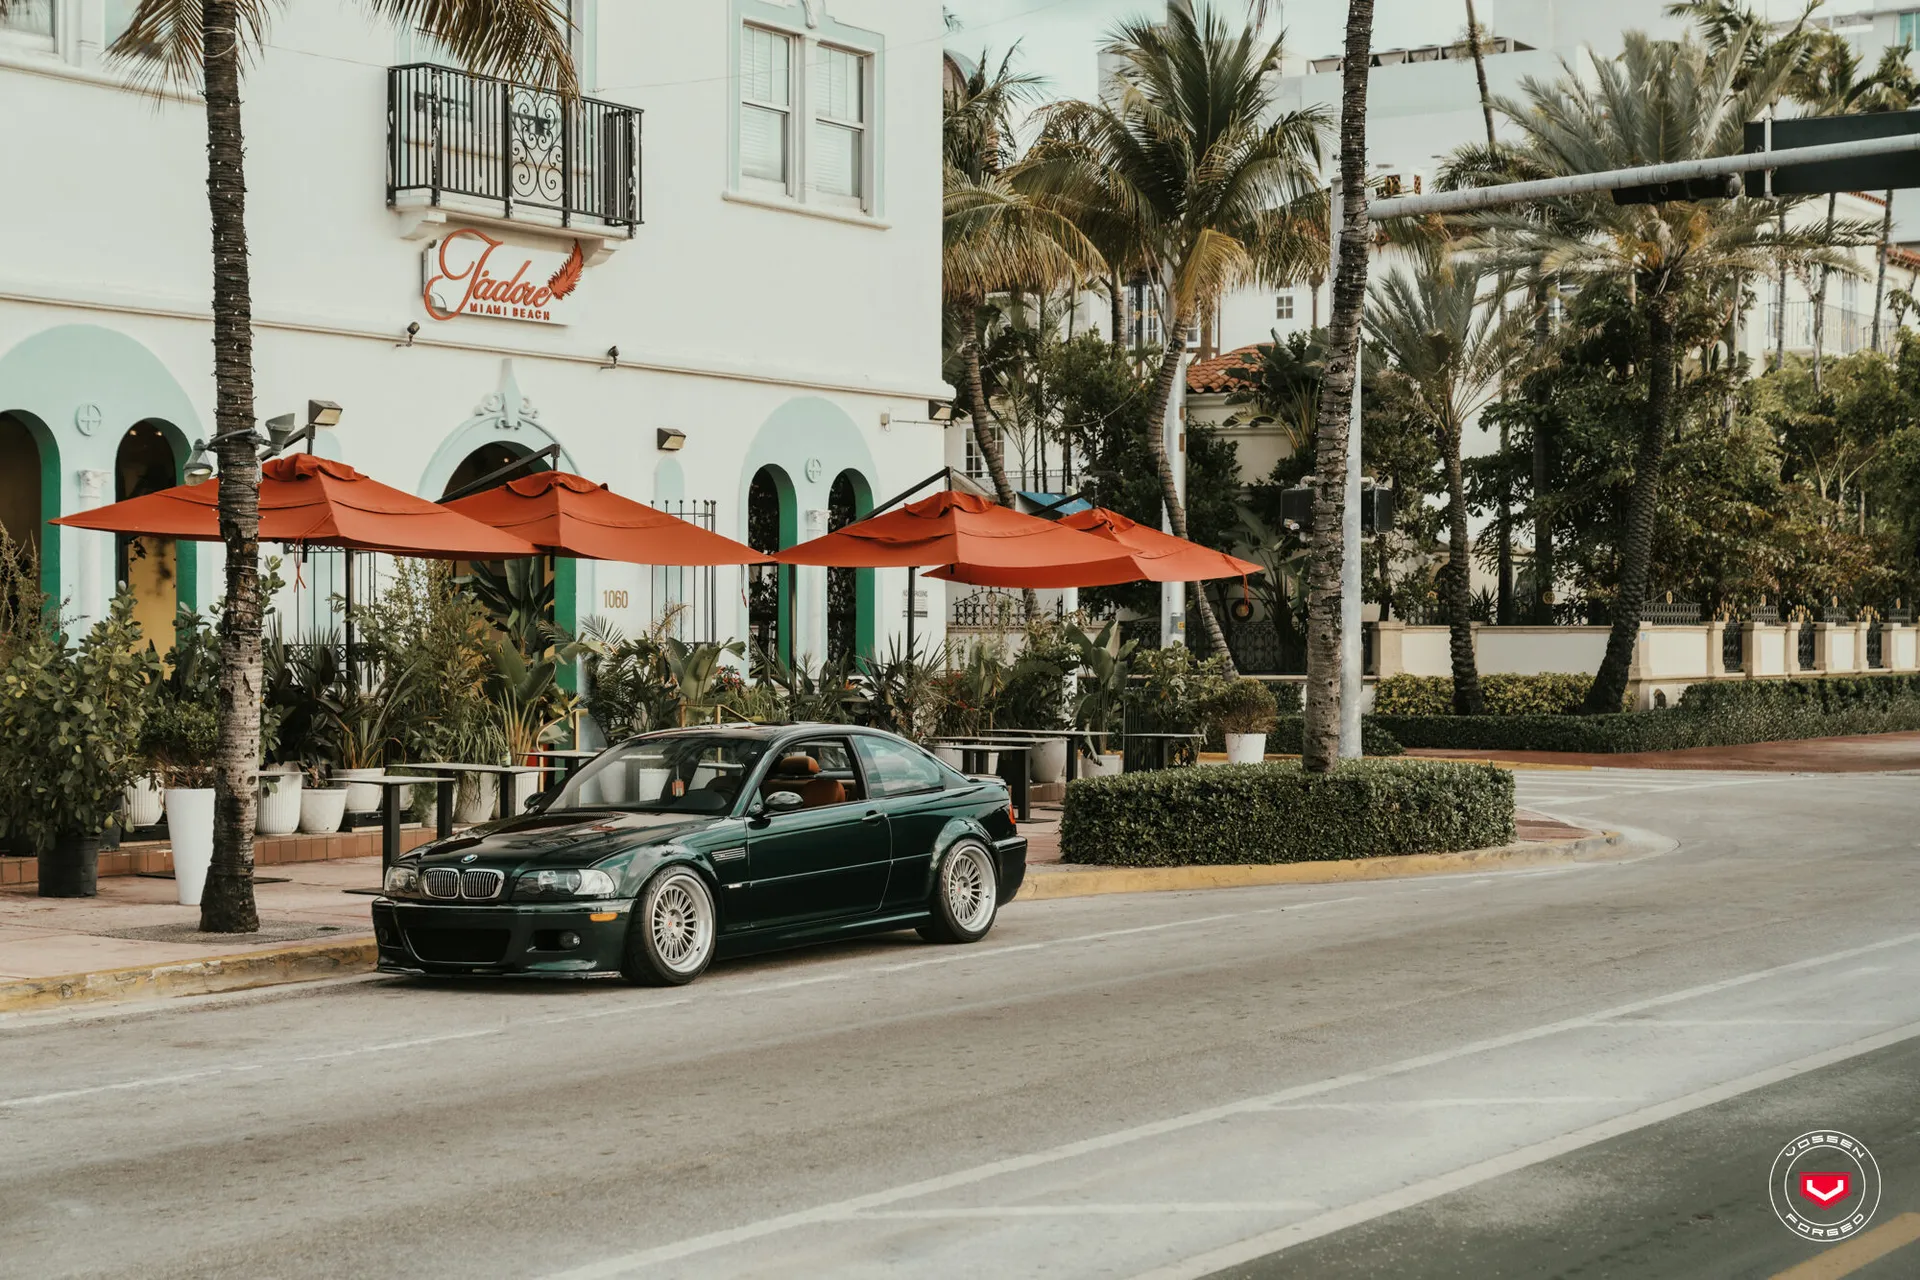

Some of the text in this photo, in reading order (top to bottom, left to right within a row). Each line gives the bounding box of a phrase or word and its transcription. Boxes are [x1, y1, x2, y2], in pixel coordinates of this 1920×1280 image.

[470, 302, 551, 321] MIAMI BEACH
[603, 589, 629, 609] 1060
